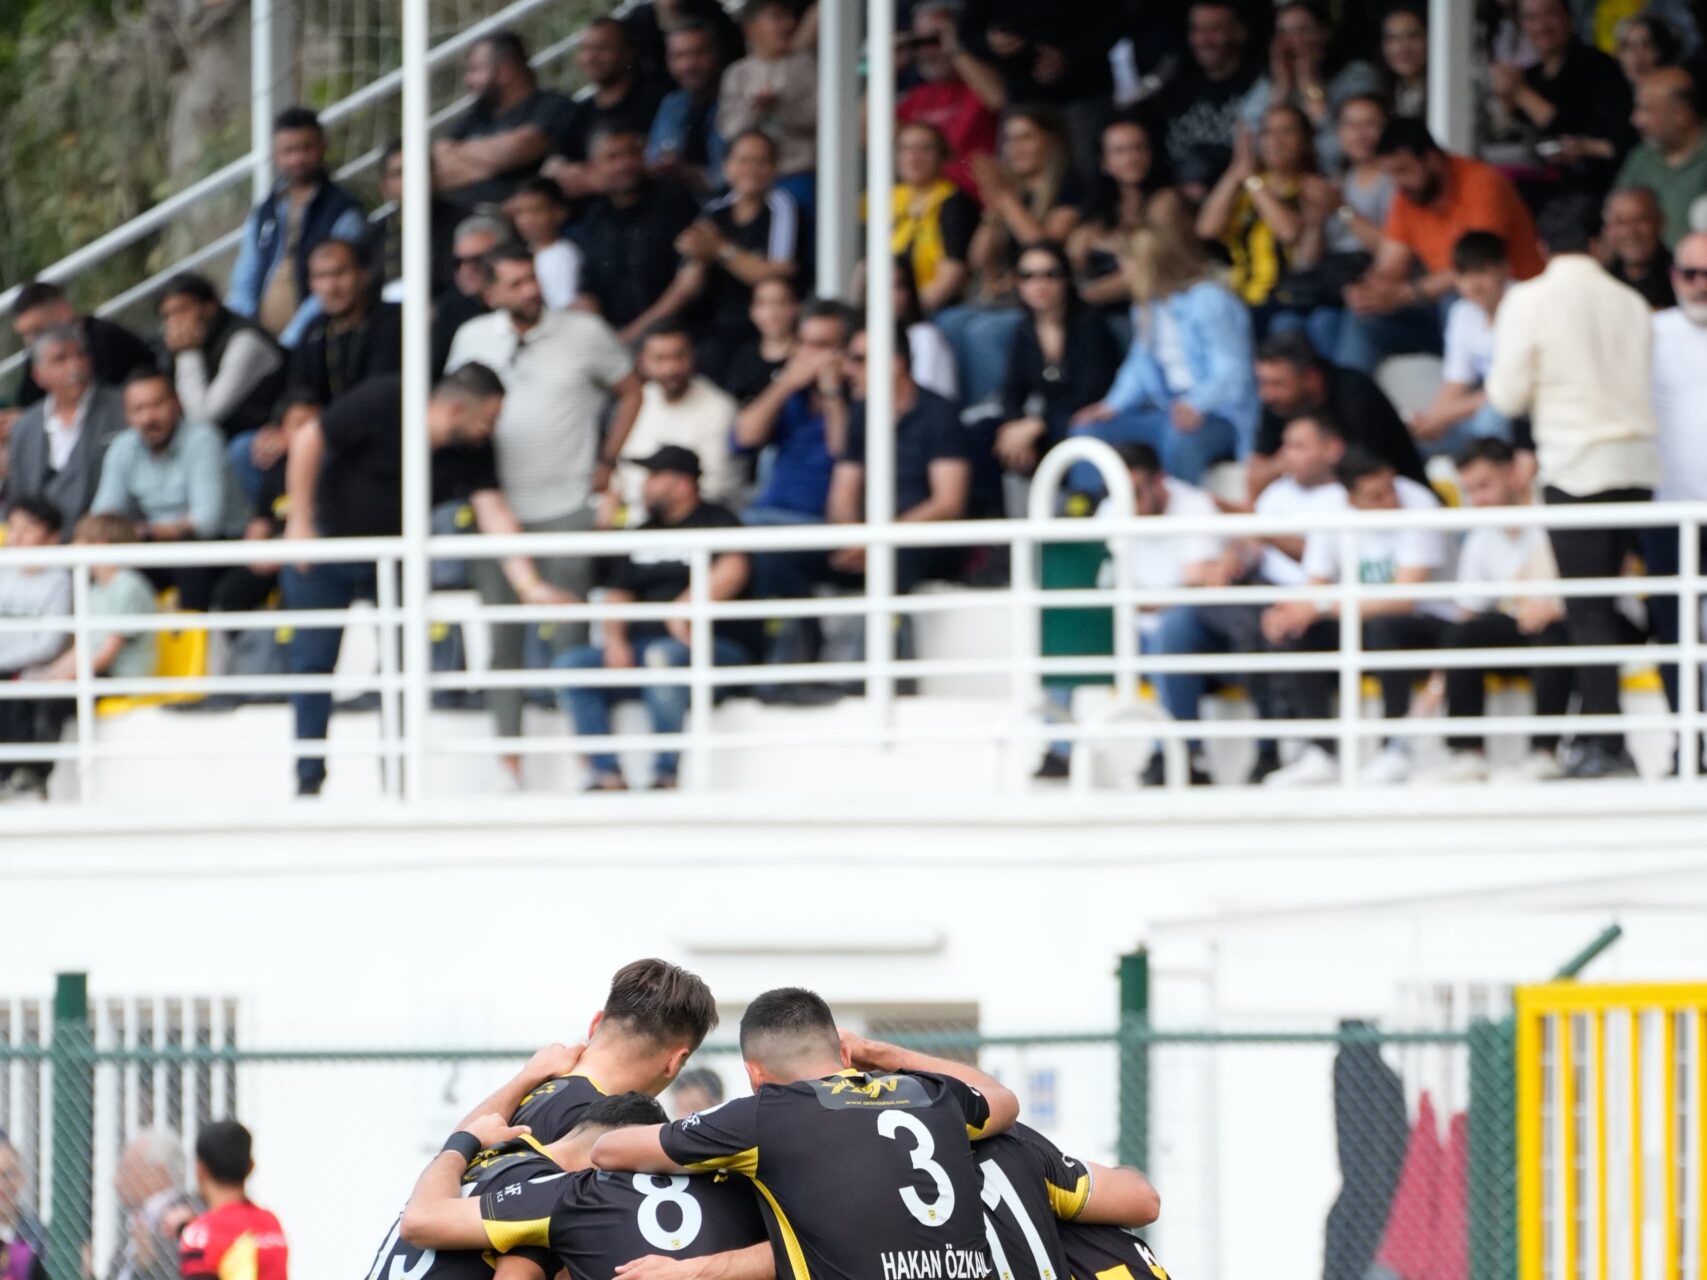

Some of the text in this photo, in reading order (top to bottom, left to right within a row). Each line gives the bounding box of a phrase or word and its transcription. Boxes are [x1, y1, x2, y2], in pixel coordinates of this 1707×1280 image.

[877, 1109, 956, 1227] 3
[632, 1173, 702, 1251] 8
[880, 1250, 942, 1280] HAKAN
